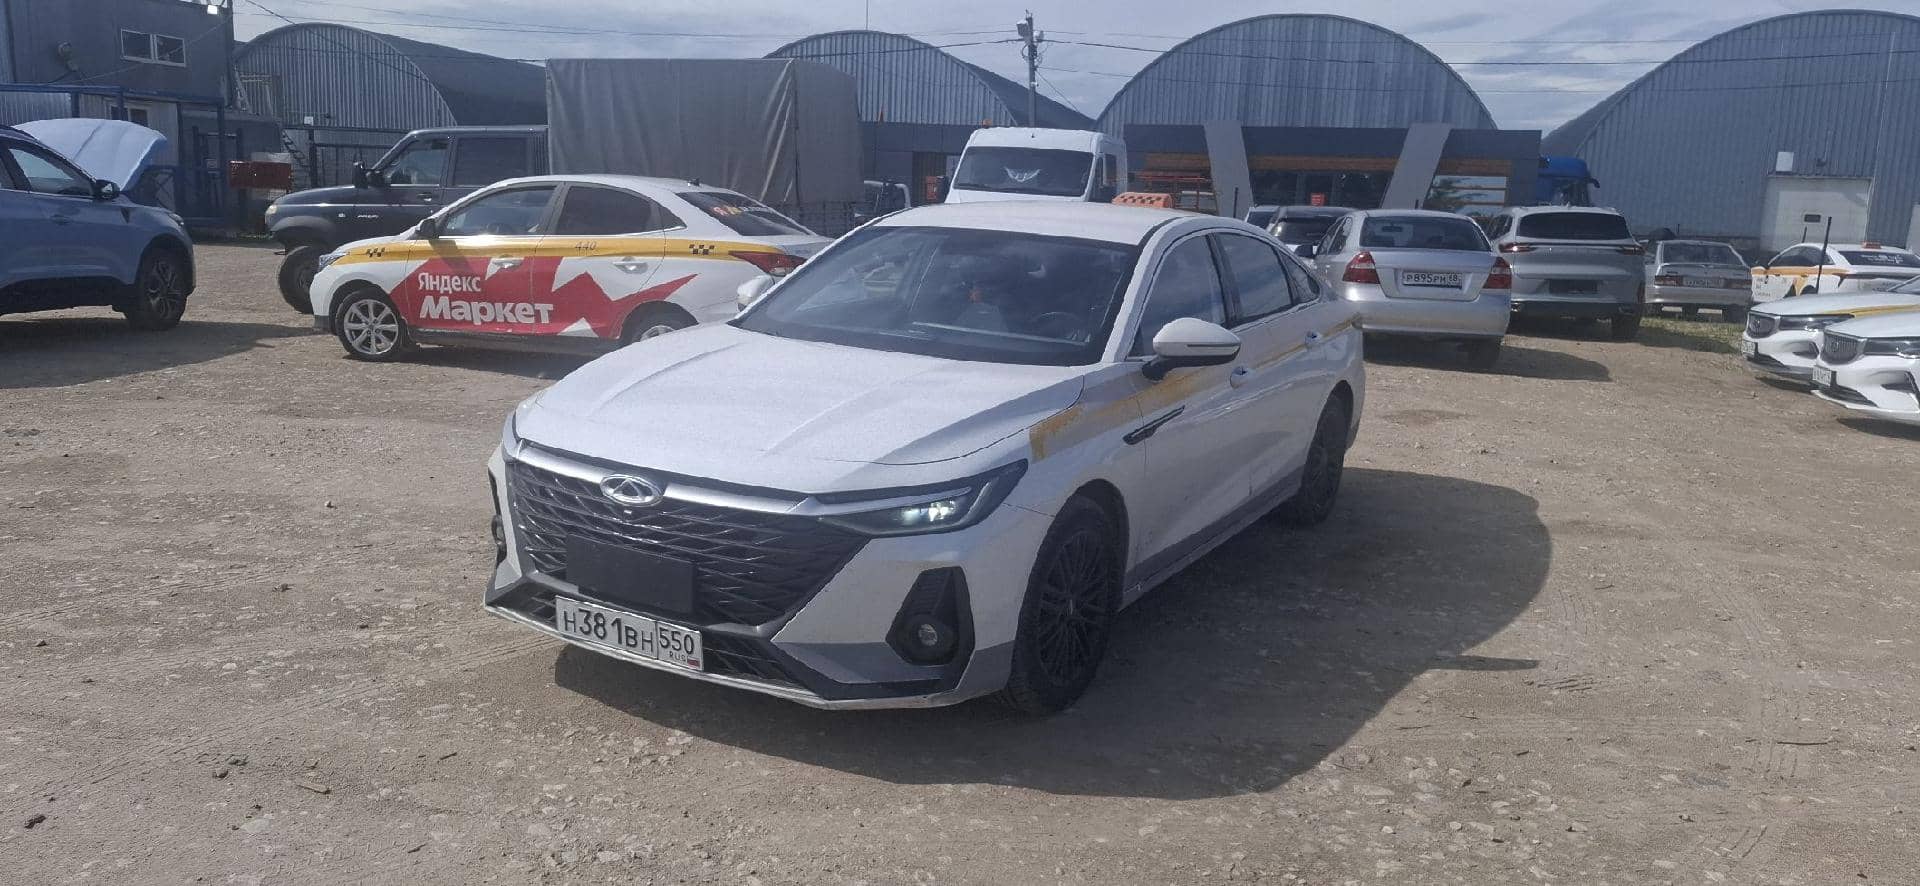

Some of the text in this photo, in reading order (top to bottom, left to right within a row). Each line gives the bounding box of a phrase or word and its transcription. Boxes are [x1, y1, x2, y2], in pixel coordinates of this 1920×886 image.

[418, 272, 481, 293] Яндекс
[419, 295, 554, 325] Маркет
[658, 626, 694, 655] 550
